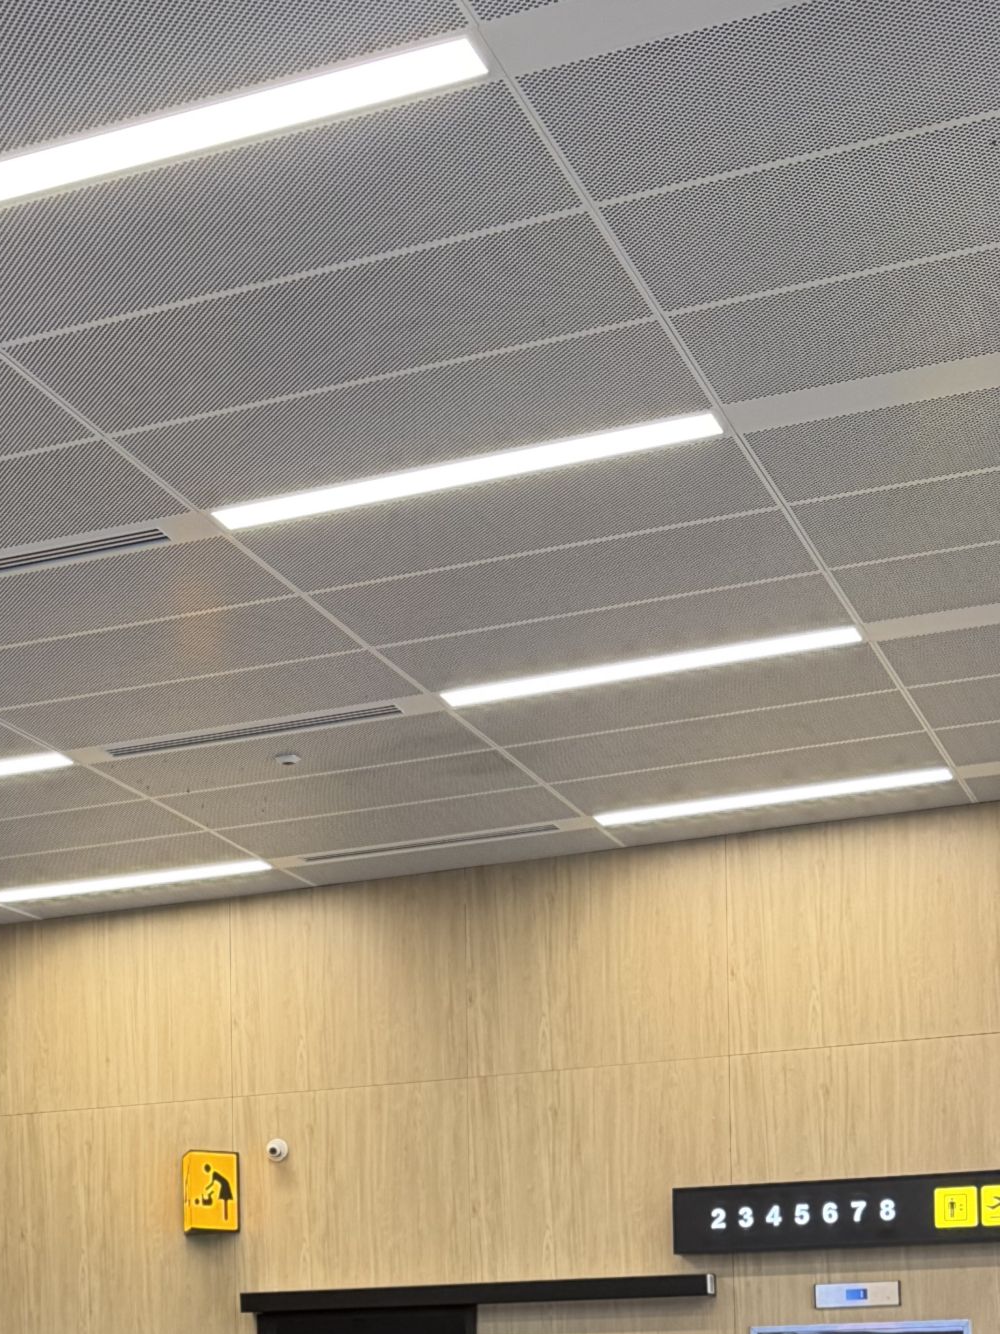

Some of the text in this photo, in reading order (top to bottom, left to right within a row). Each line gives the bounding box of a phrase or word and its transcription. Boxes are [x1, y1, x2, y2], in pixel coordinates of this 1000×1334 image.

[710, 1198, 896, 1230] 2 3 4 5 6 7 8
